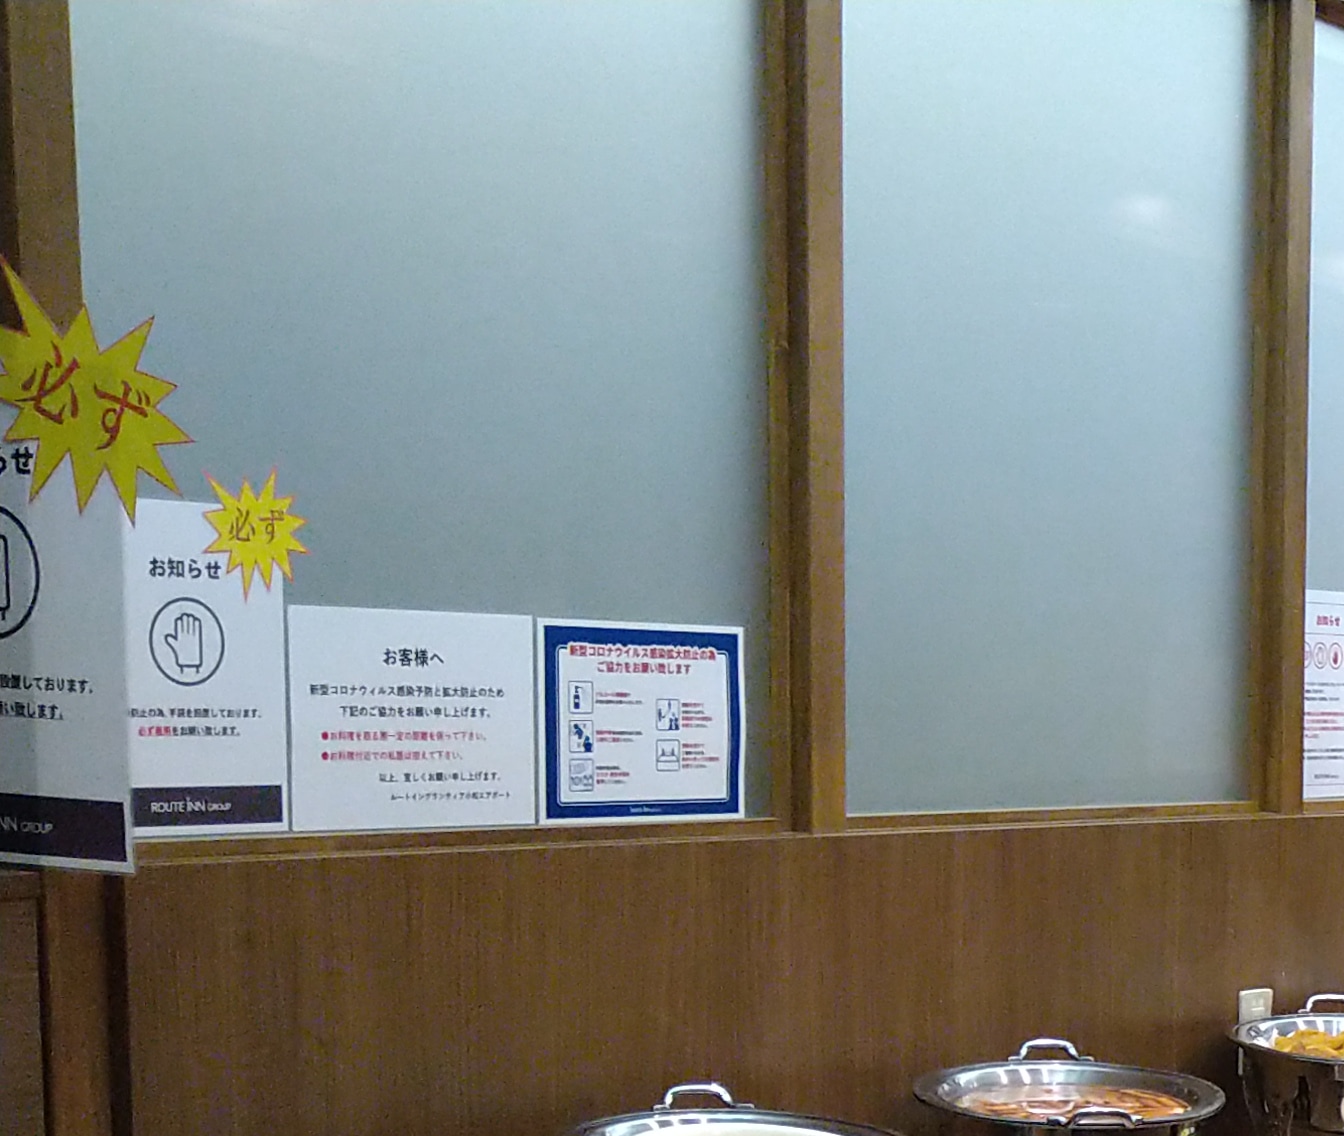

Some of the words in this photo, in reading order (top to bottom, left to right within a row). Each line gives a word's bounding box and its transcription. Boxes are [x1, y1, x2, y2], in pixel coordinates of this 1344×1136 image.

[15, 340, 151, 450] 必ず
[228, 506, 285, 544] 必ず
[149, 556, 221, 580] お知らせ
[382, 648, 445, 667] お客様へ
[150, 801, 185, 814] ROUTE
